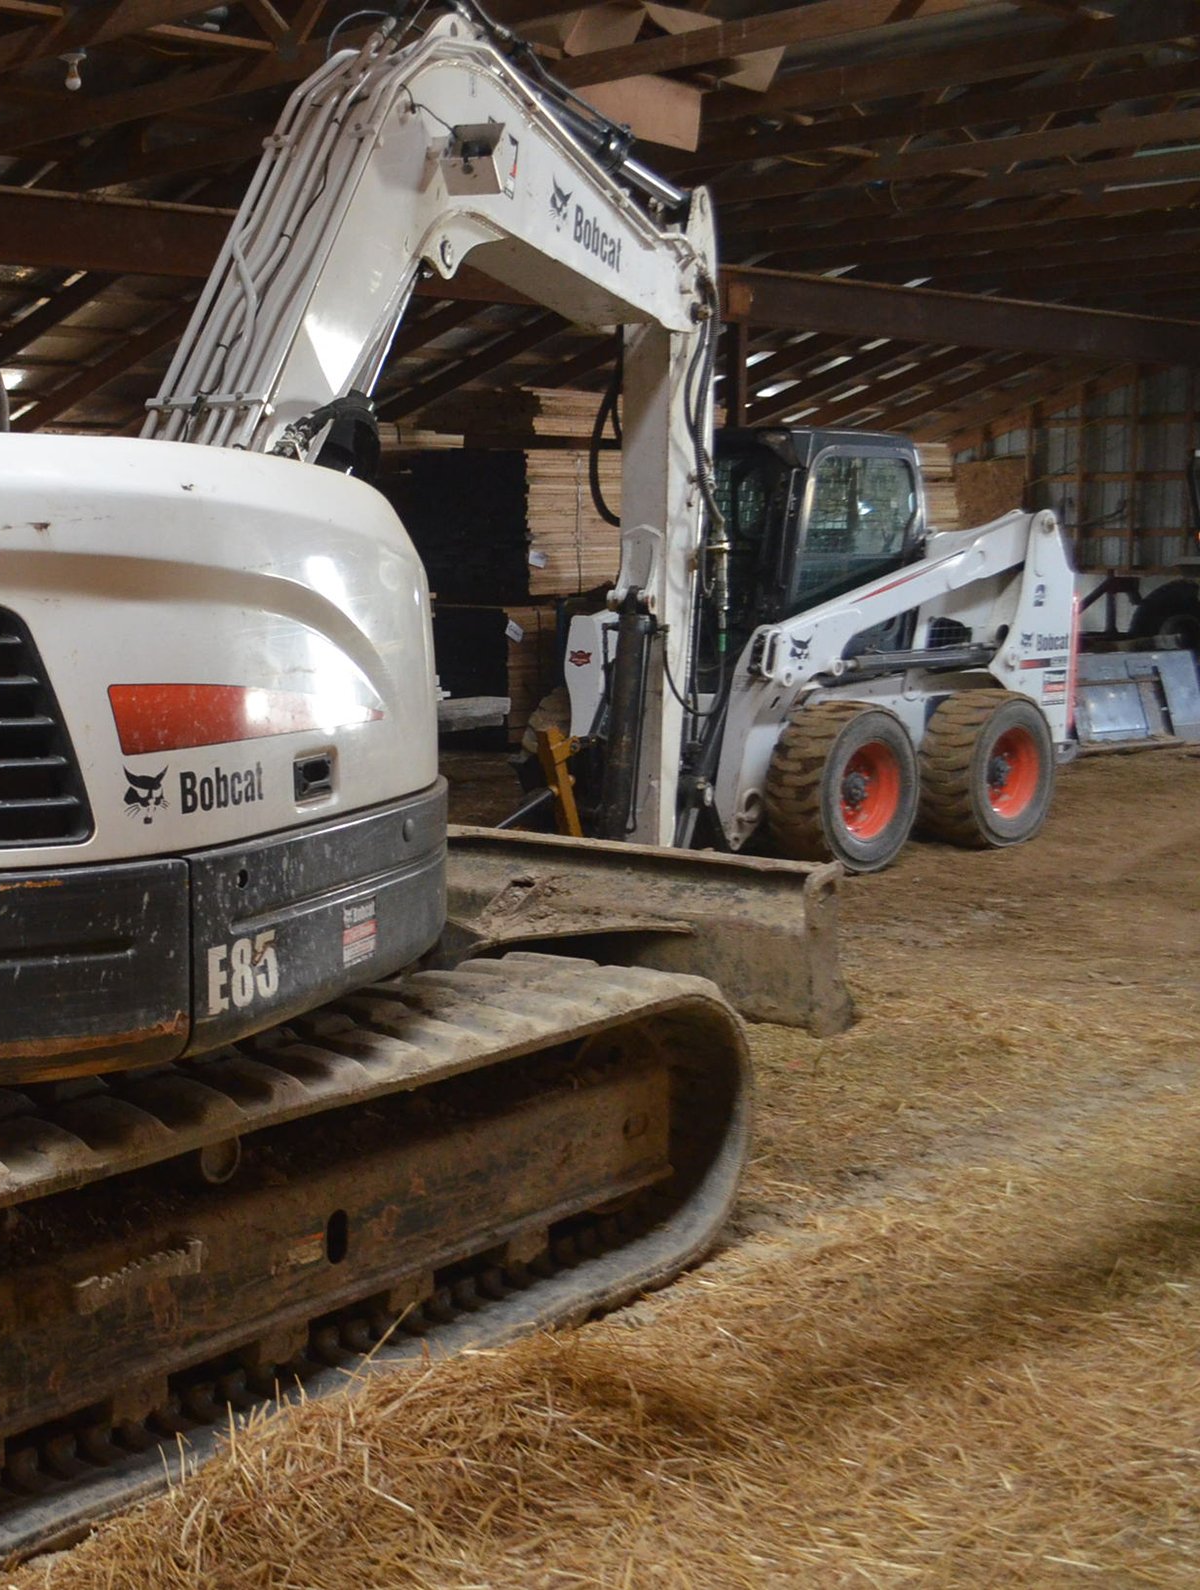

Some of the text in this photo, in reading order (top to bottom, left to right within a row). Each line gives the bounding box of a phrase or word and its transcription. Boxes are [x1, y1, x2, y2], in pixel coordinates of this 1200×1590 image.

[573, 203, 622, 273] Bobcat
[1037, 633, 1069, 652] Bobcat
[179, 761, 264, 815] Bobcat
[207, 928, 280, 1016] E85
